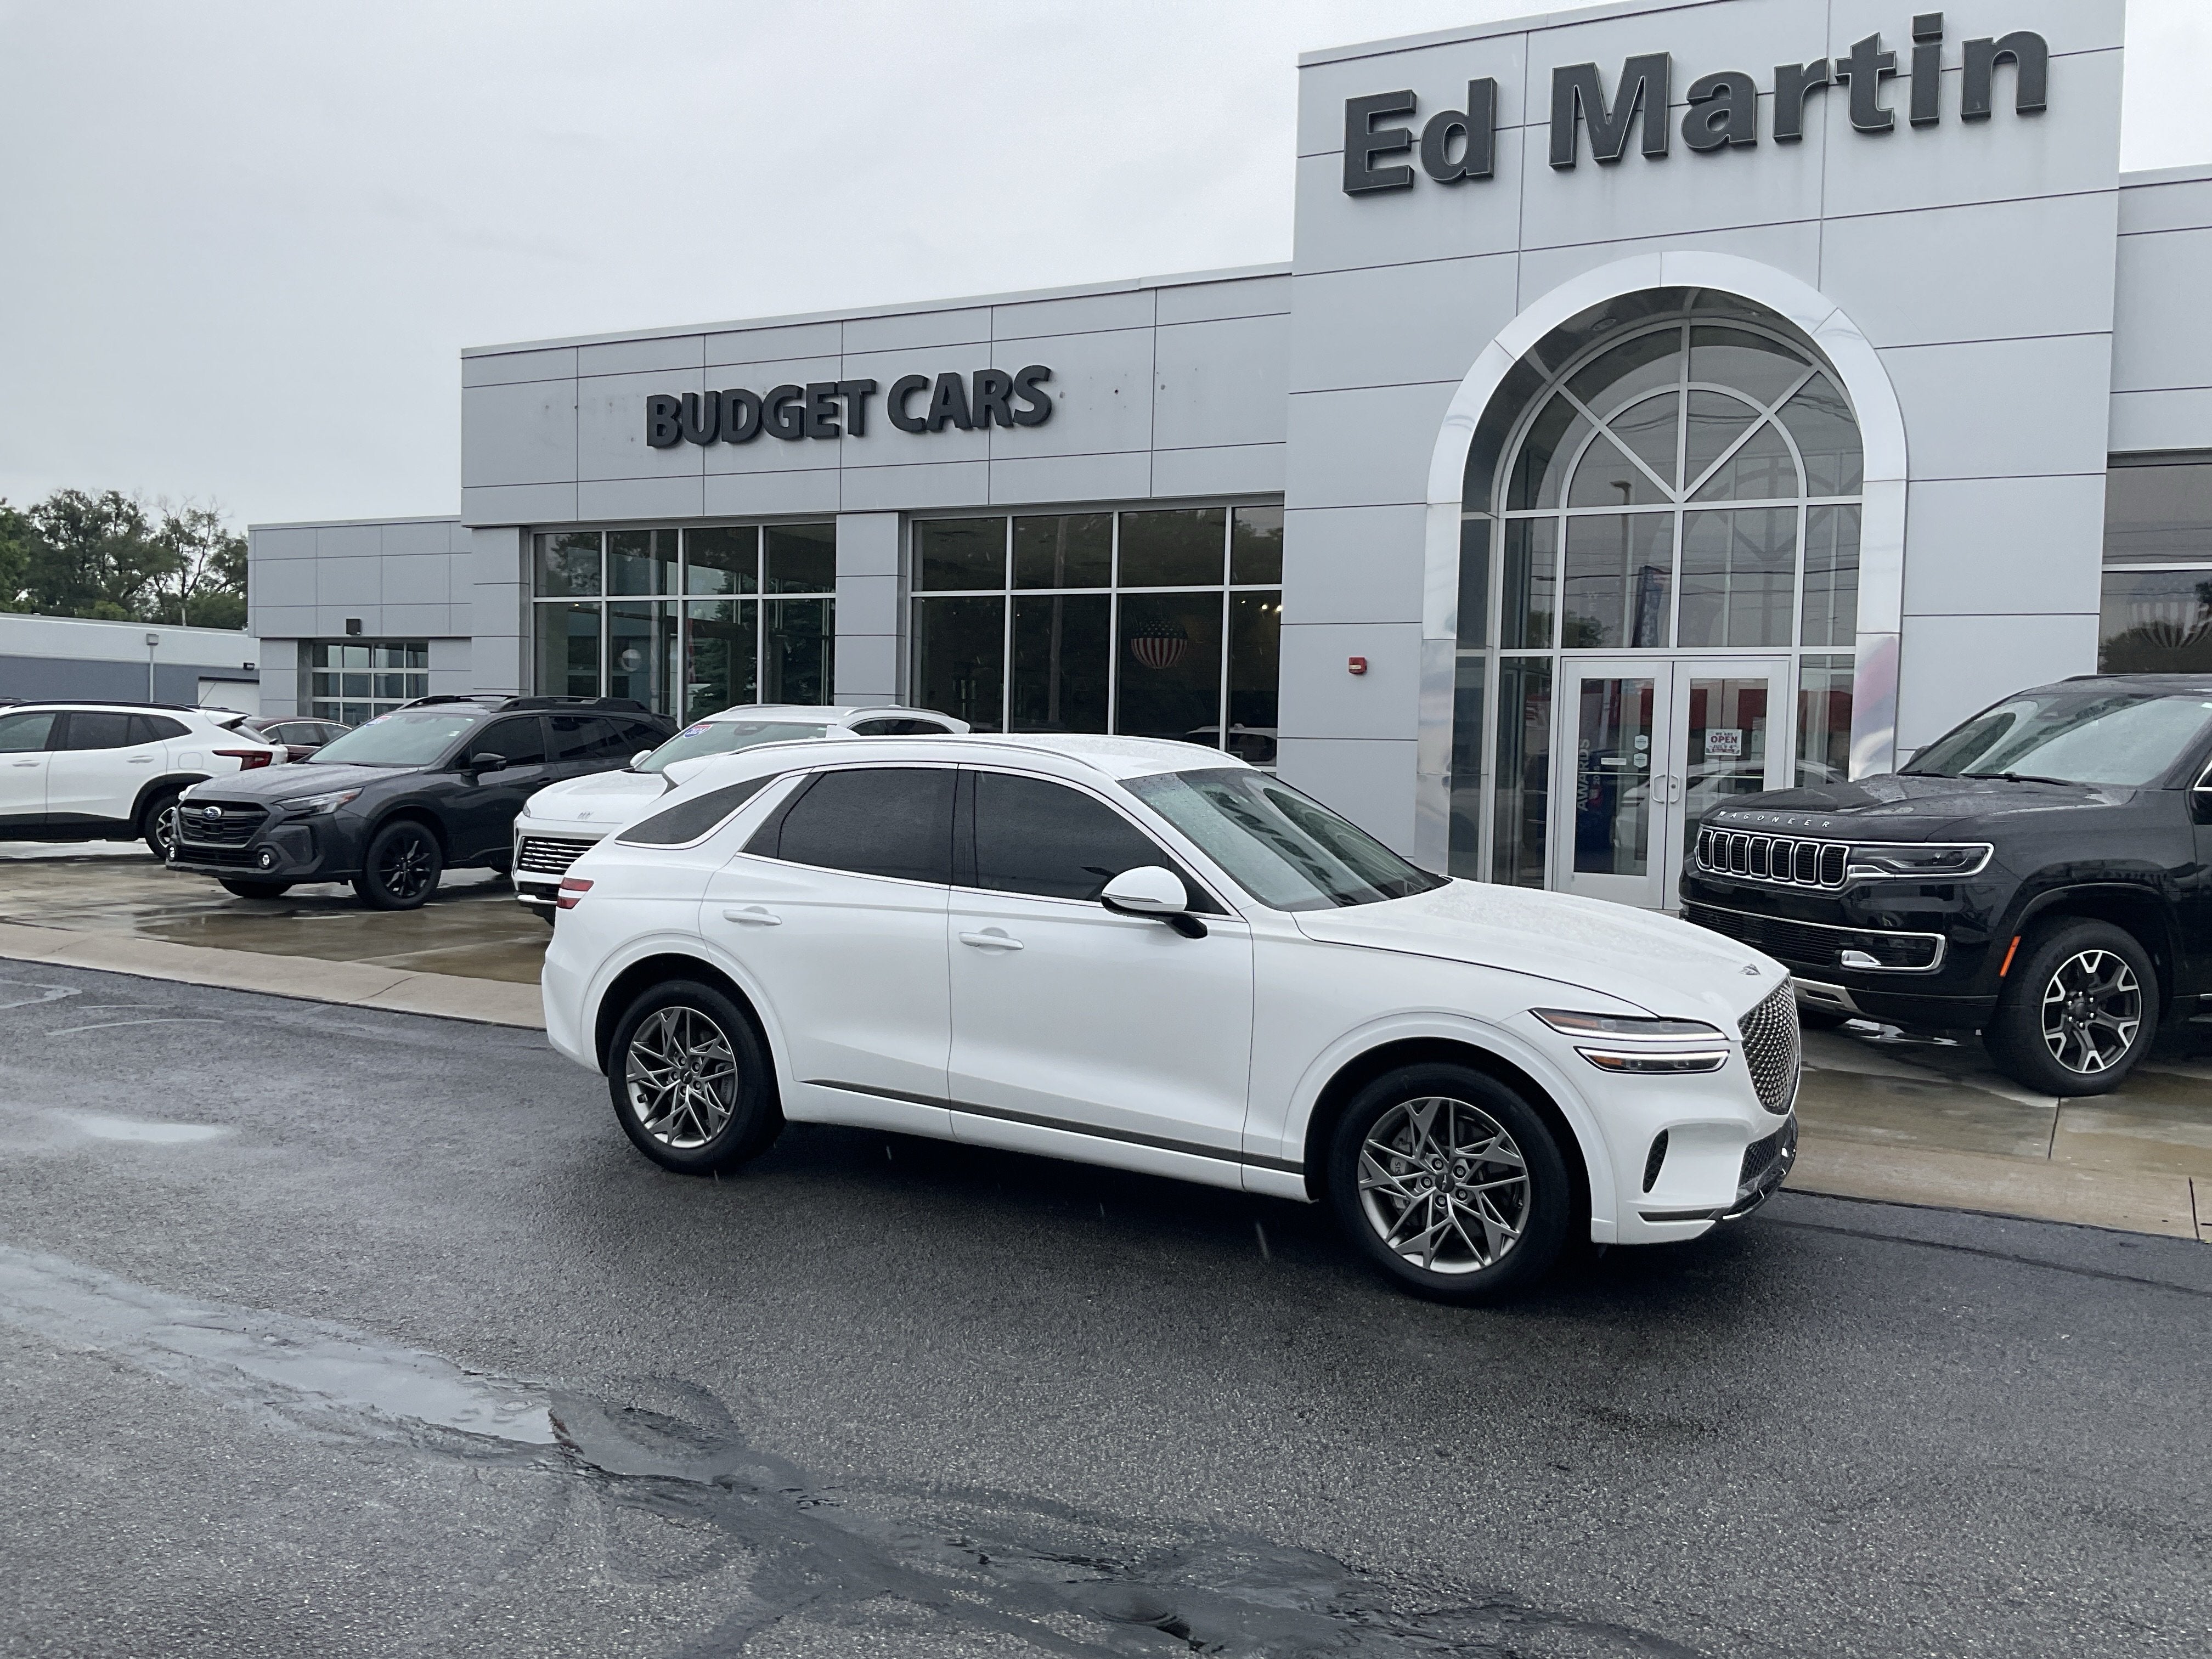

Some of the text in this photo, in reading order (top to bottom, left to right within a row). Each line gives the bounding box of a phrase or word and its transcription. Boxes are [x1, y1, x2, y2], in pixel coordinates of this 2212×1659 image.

[1342, 12, 2049, 196] Ed Martin
[646, 365, 1052, 447] BUDGET CARS
[1576, 738, 1590, 811] AWARDS
[1718, 810, 1830, 828] WAGONEER
